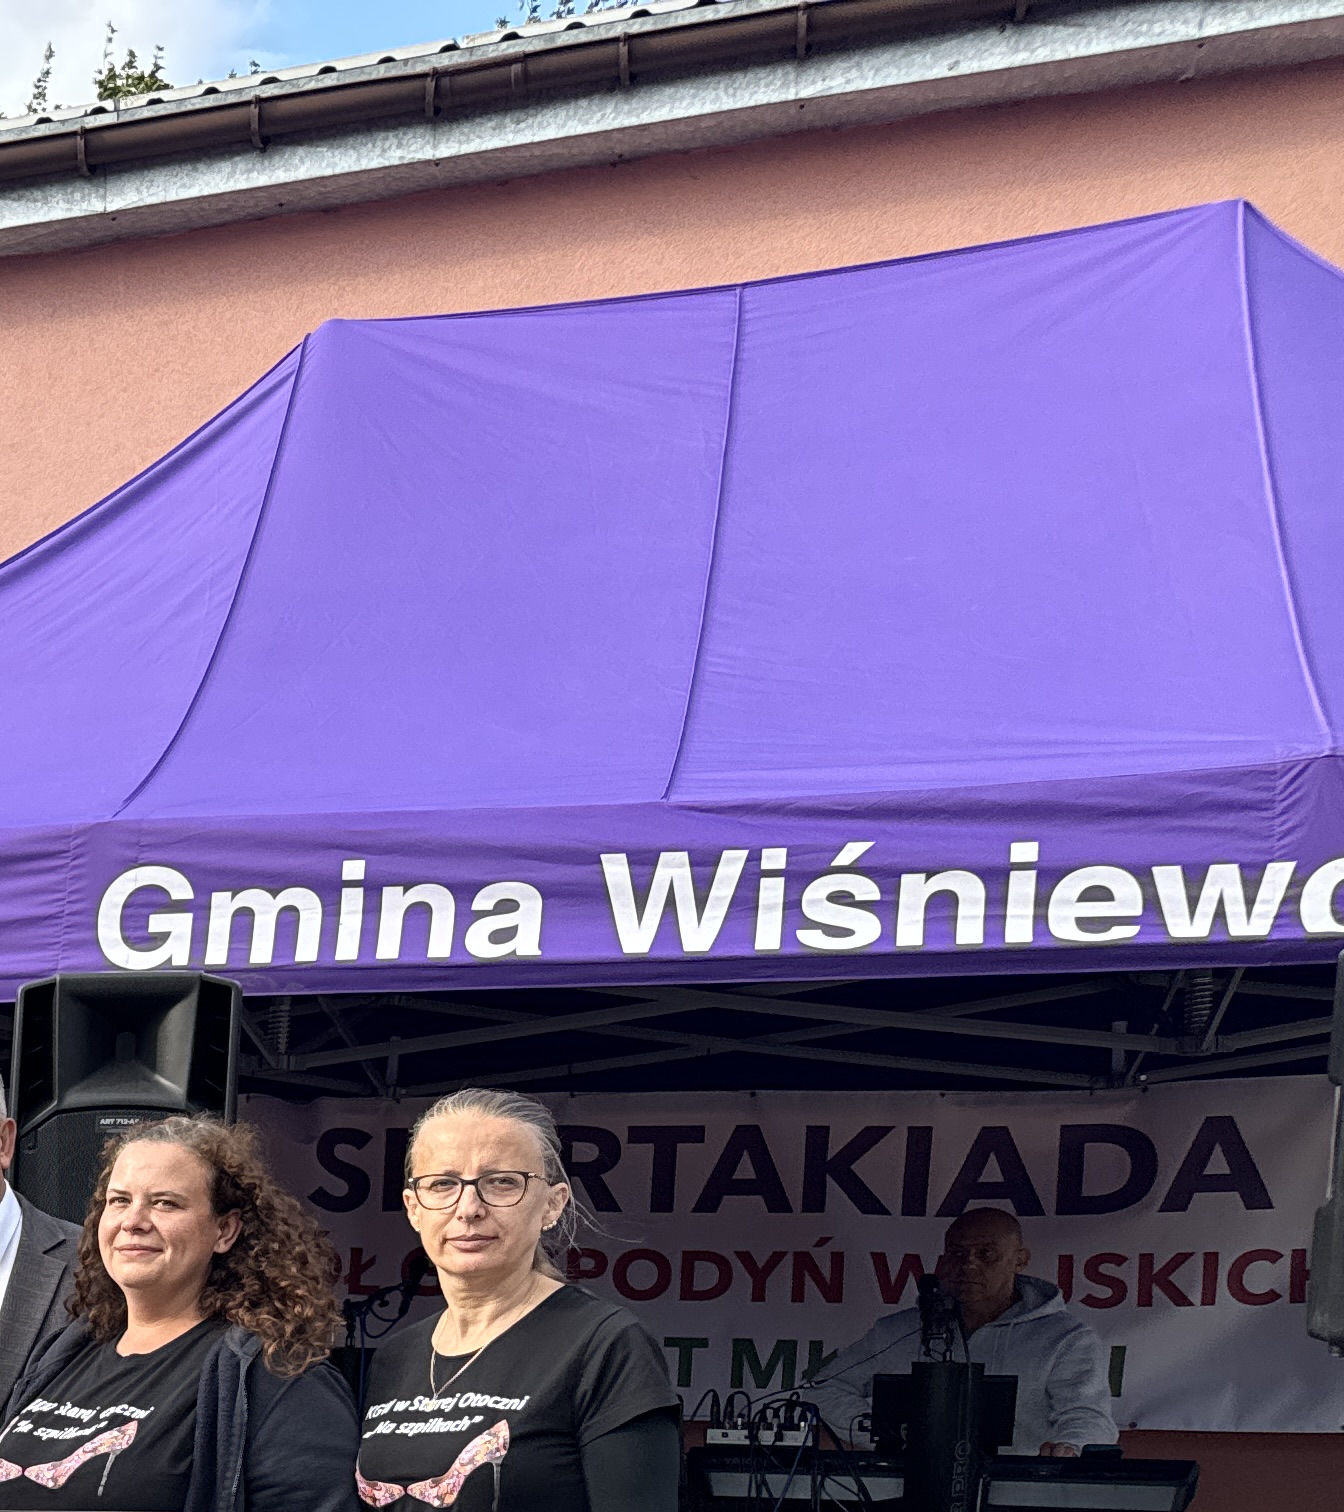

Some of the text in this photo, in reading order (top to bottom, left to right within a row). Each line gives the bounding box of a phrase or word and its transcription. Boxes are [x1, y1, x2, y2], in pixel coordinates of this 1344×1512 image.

[97, 858, 544, 970] Gmina
[307, 1115, 1274, 1217] SRTAKIADA
[401, 1236, 845, 1304] GPODYŃ
[869, 1248, 1311, 1309] WJSKIC
[393, 1400, 411, 1412] w
[458, 1392, 530, 1411] Otoczni
